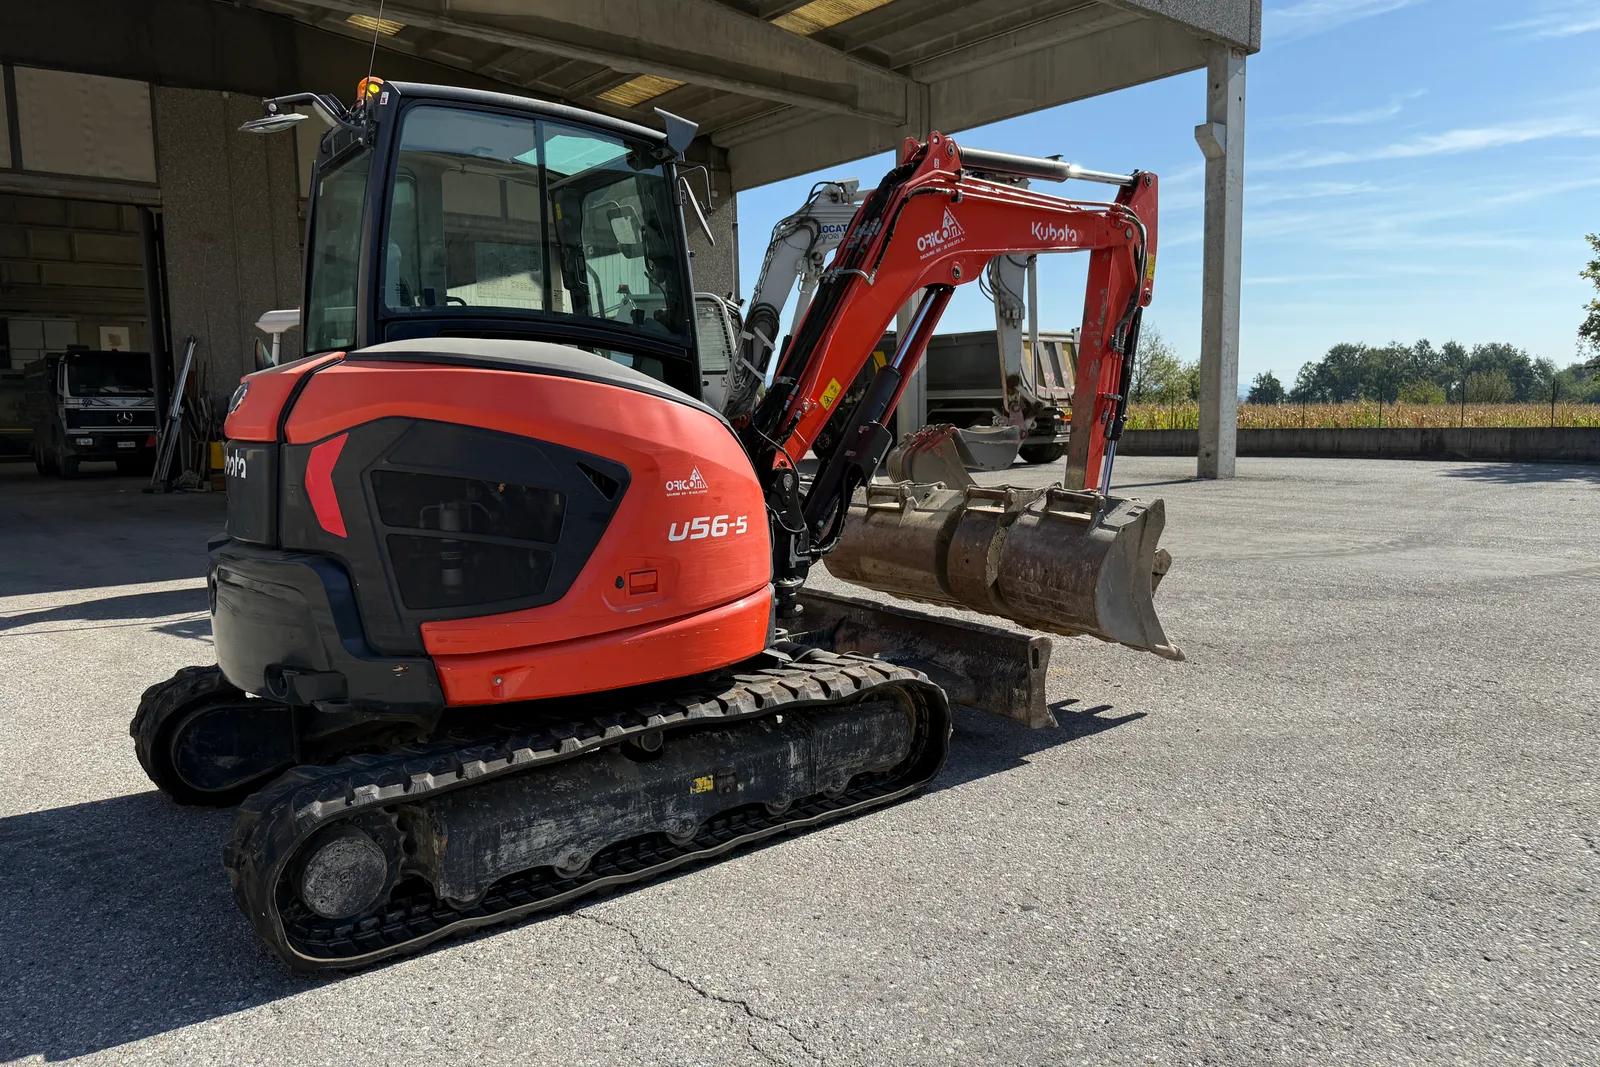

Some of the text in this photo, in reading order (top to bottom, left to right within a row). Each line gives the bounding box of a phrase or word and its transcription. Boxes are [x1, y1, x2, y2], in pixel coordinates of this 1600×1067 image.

[820, 224, 848, 233] OCAT
[1031, 221, 1077, 242] Kubota
[224, 447, 247, 479] bota
[668, 514, 748, 542] U56-5
